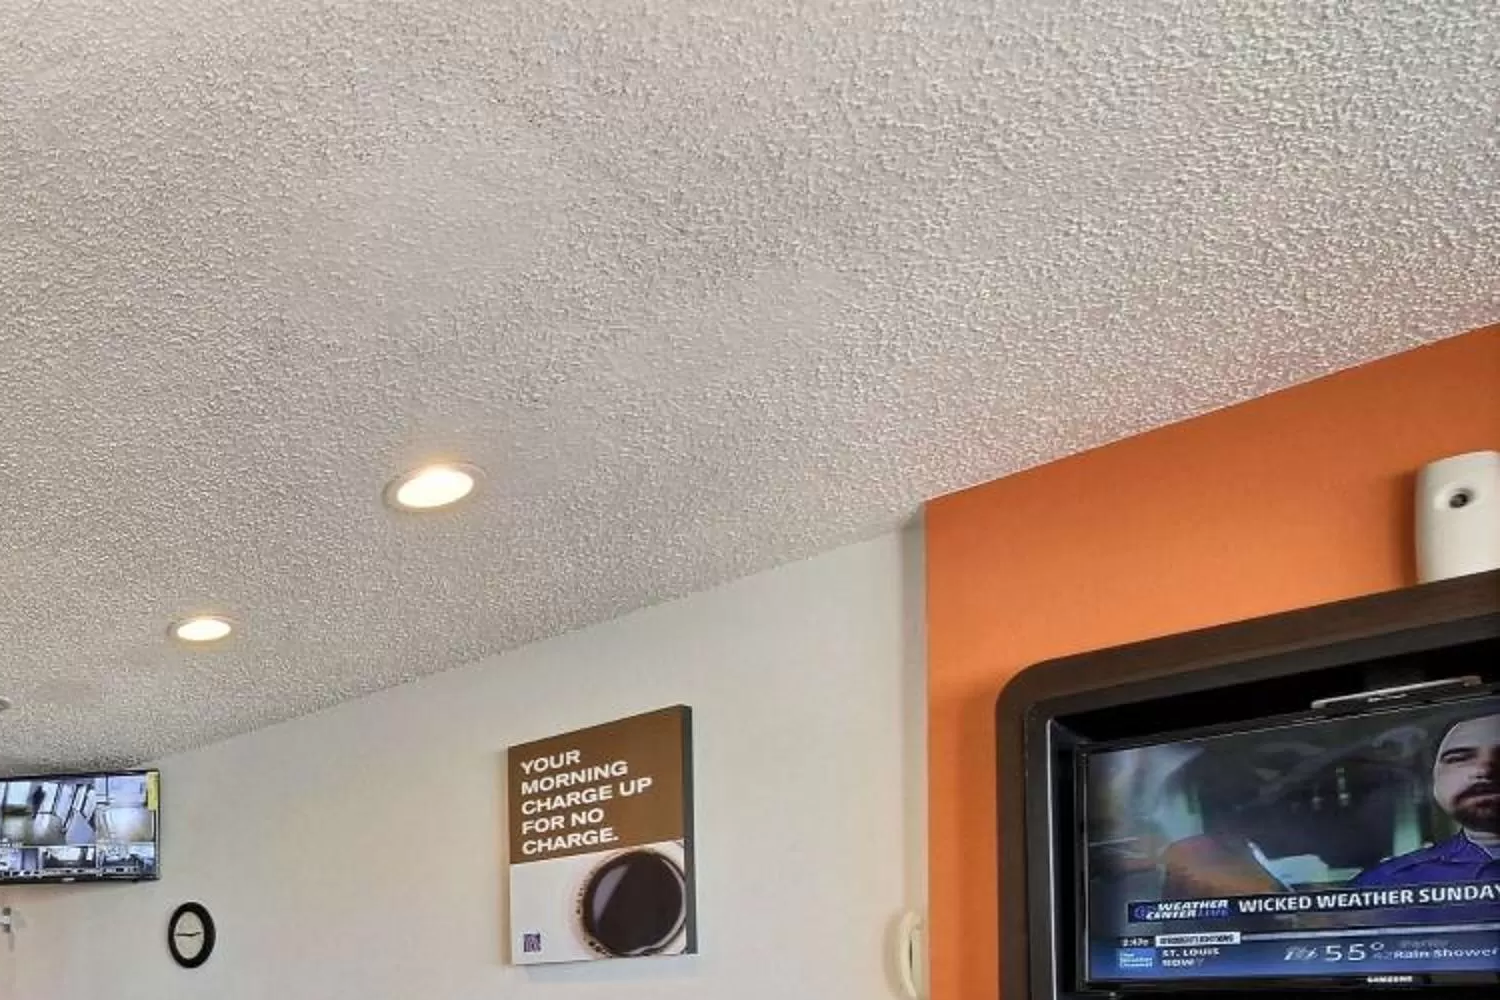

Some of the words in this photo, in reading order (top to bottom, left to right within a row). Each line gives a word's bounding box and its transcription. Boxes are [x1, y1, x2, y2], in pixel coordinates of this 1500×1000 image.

[520, 749, 580, 775] YOUR
[521, 760, 628, 796] MORNING
[521, 784, 613, 815] CHARGE
[618, 777, 653, 797] UP
[521, 815, 565, 835] FOR
[571, 808, 605, 827] NO
[521, 828, 619, 855] CHARGE.
[1157, 899, 1230, 911] WEATHER
[1238, 895, 1311, 913] WICKED
[1316, 889, 1414, 910] WEATHER
[1145, 909, 1197, 920] CENTER
[1393, 949, 1430, 959] Rain
